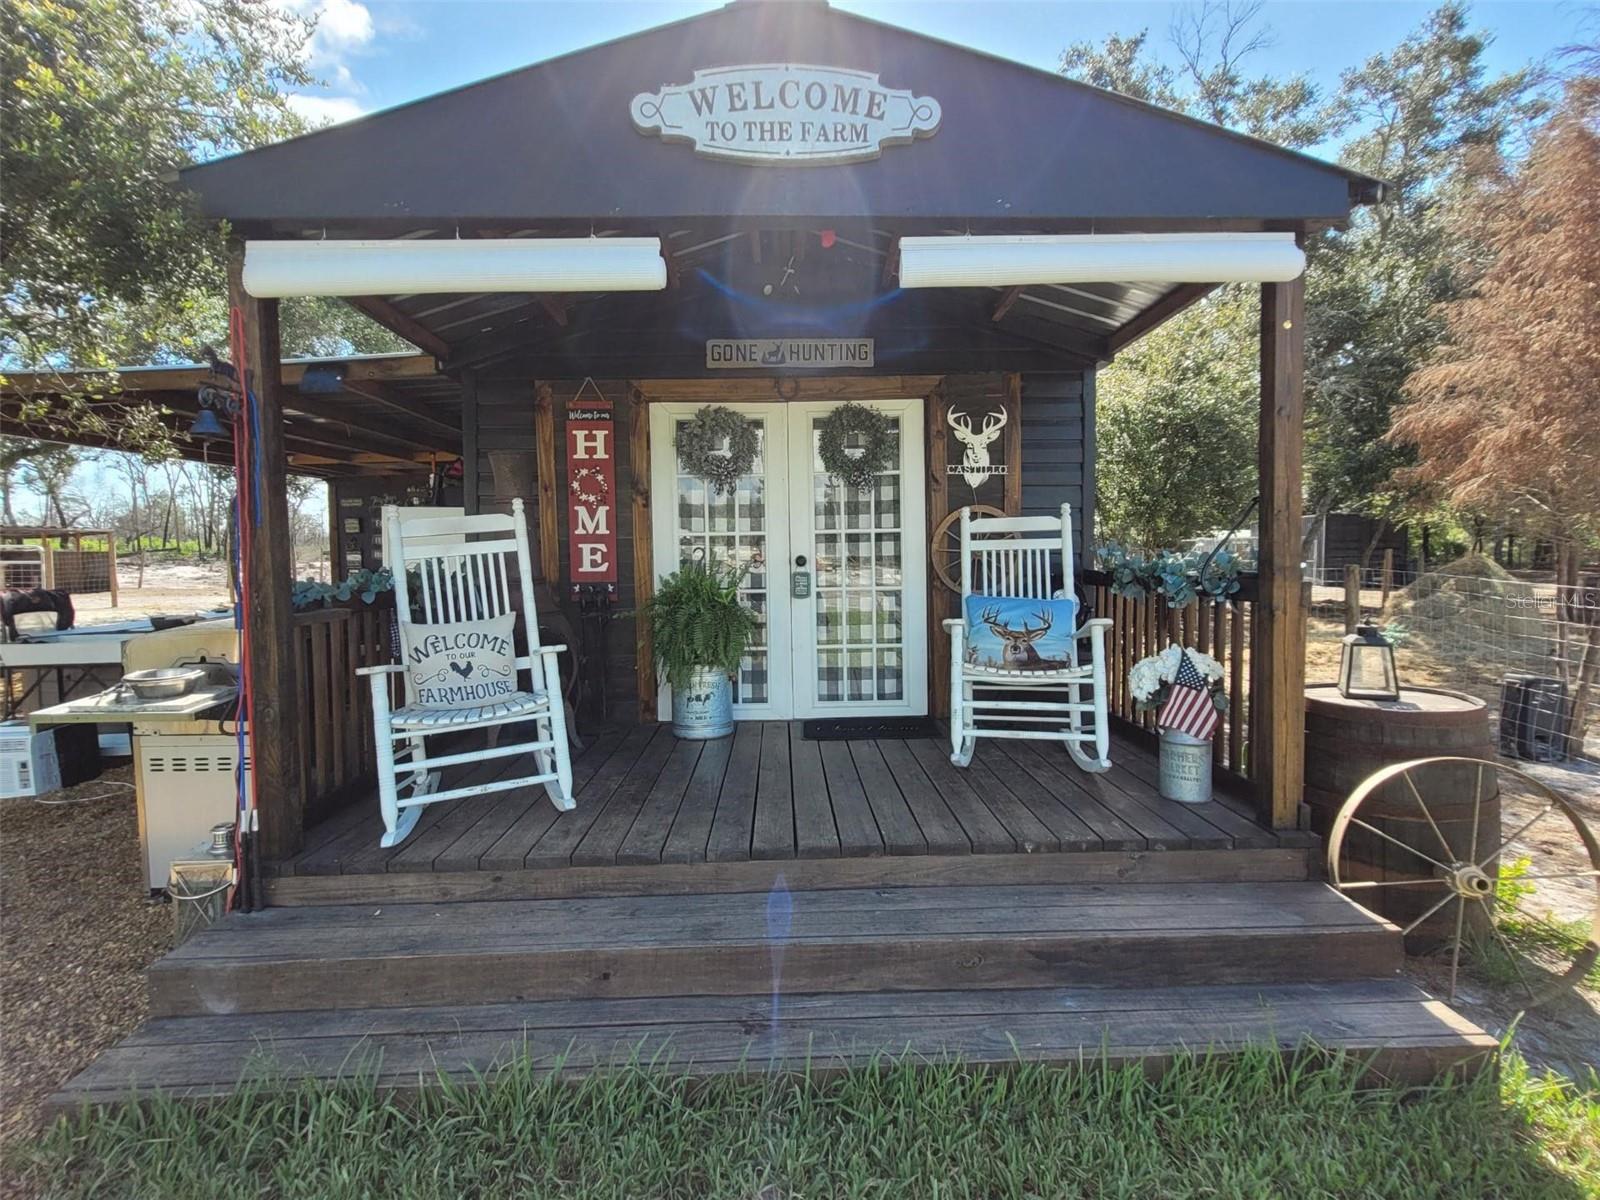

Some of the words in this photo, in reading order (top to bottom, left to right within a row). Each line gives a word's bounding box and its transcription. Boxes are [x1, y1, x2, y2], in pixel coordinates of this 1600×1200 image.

[688, 80, 888, 121] WELCOME
[706, 122, 737, 142] TO
[744, 121, 793, 142] THE
[800, 122, 869, 143] FARM
[711, 344, 758, 362] GONE
[789, 343, 869, 361] HUNTING
[946, 465, 1008, 474] CASTILLO
[570, 429, 611, 573] HOME
[408, 632, 510, 665] WELCOME
[459, 651, 476, 660] OUR
[418, 680, 513, 705] FARMHOUSE
